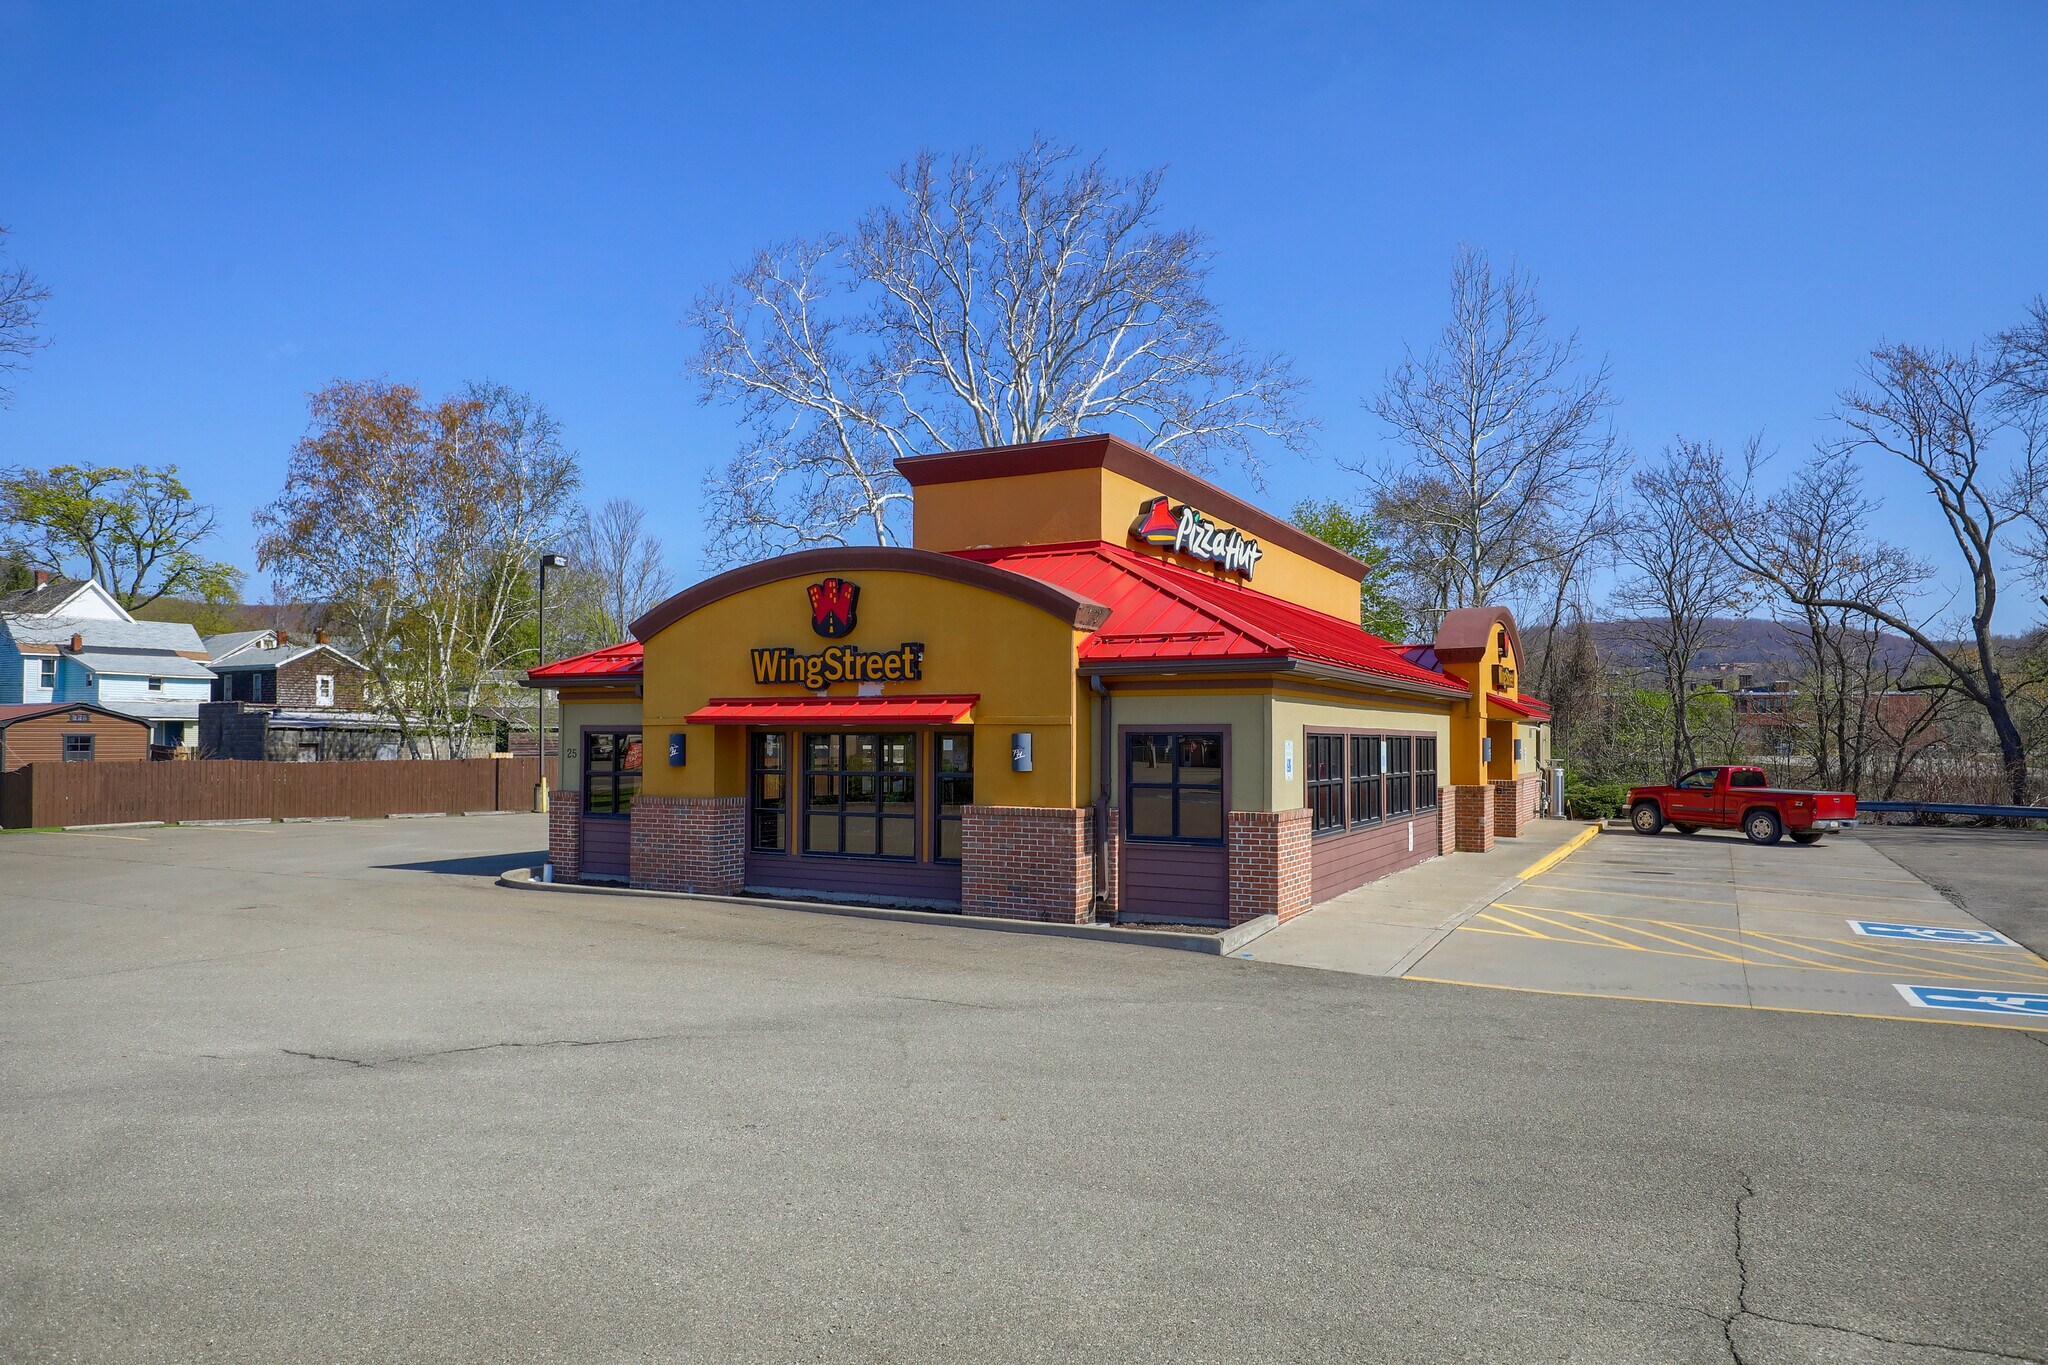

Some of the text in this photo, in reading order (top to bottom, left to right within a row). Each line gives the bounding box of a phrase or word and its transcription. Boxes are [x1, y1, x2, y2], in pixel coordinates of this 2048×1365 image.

[1175, 507, 1263, 581] Pizza Hut
[752, 645, 915, 689] WingStreet
[566, 747, 578, 759] 25
